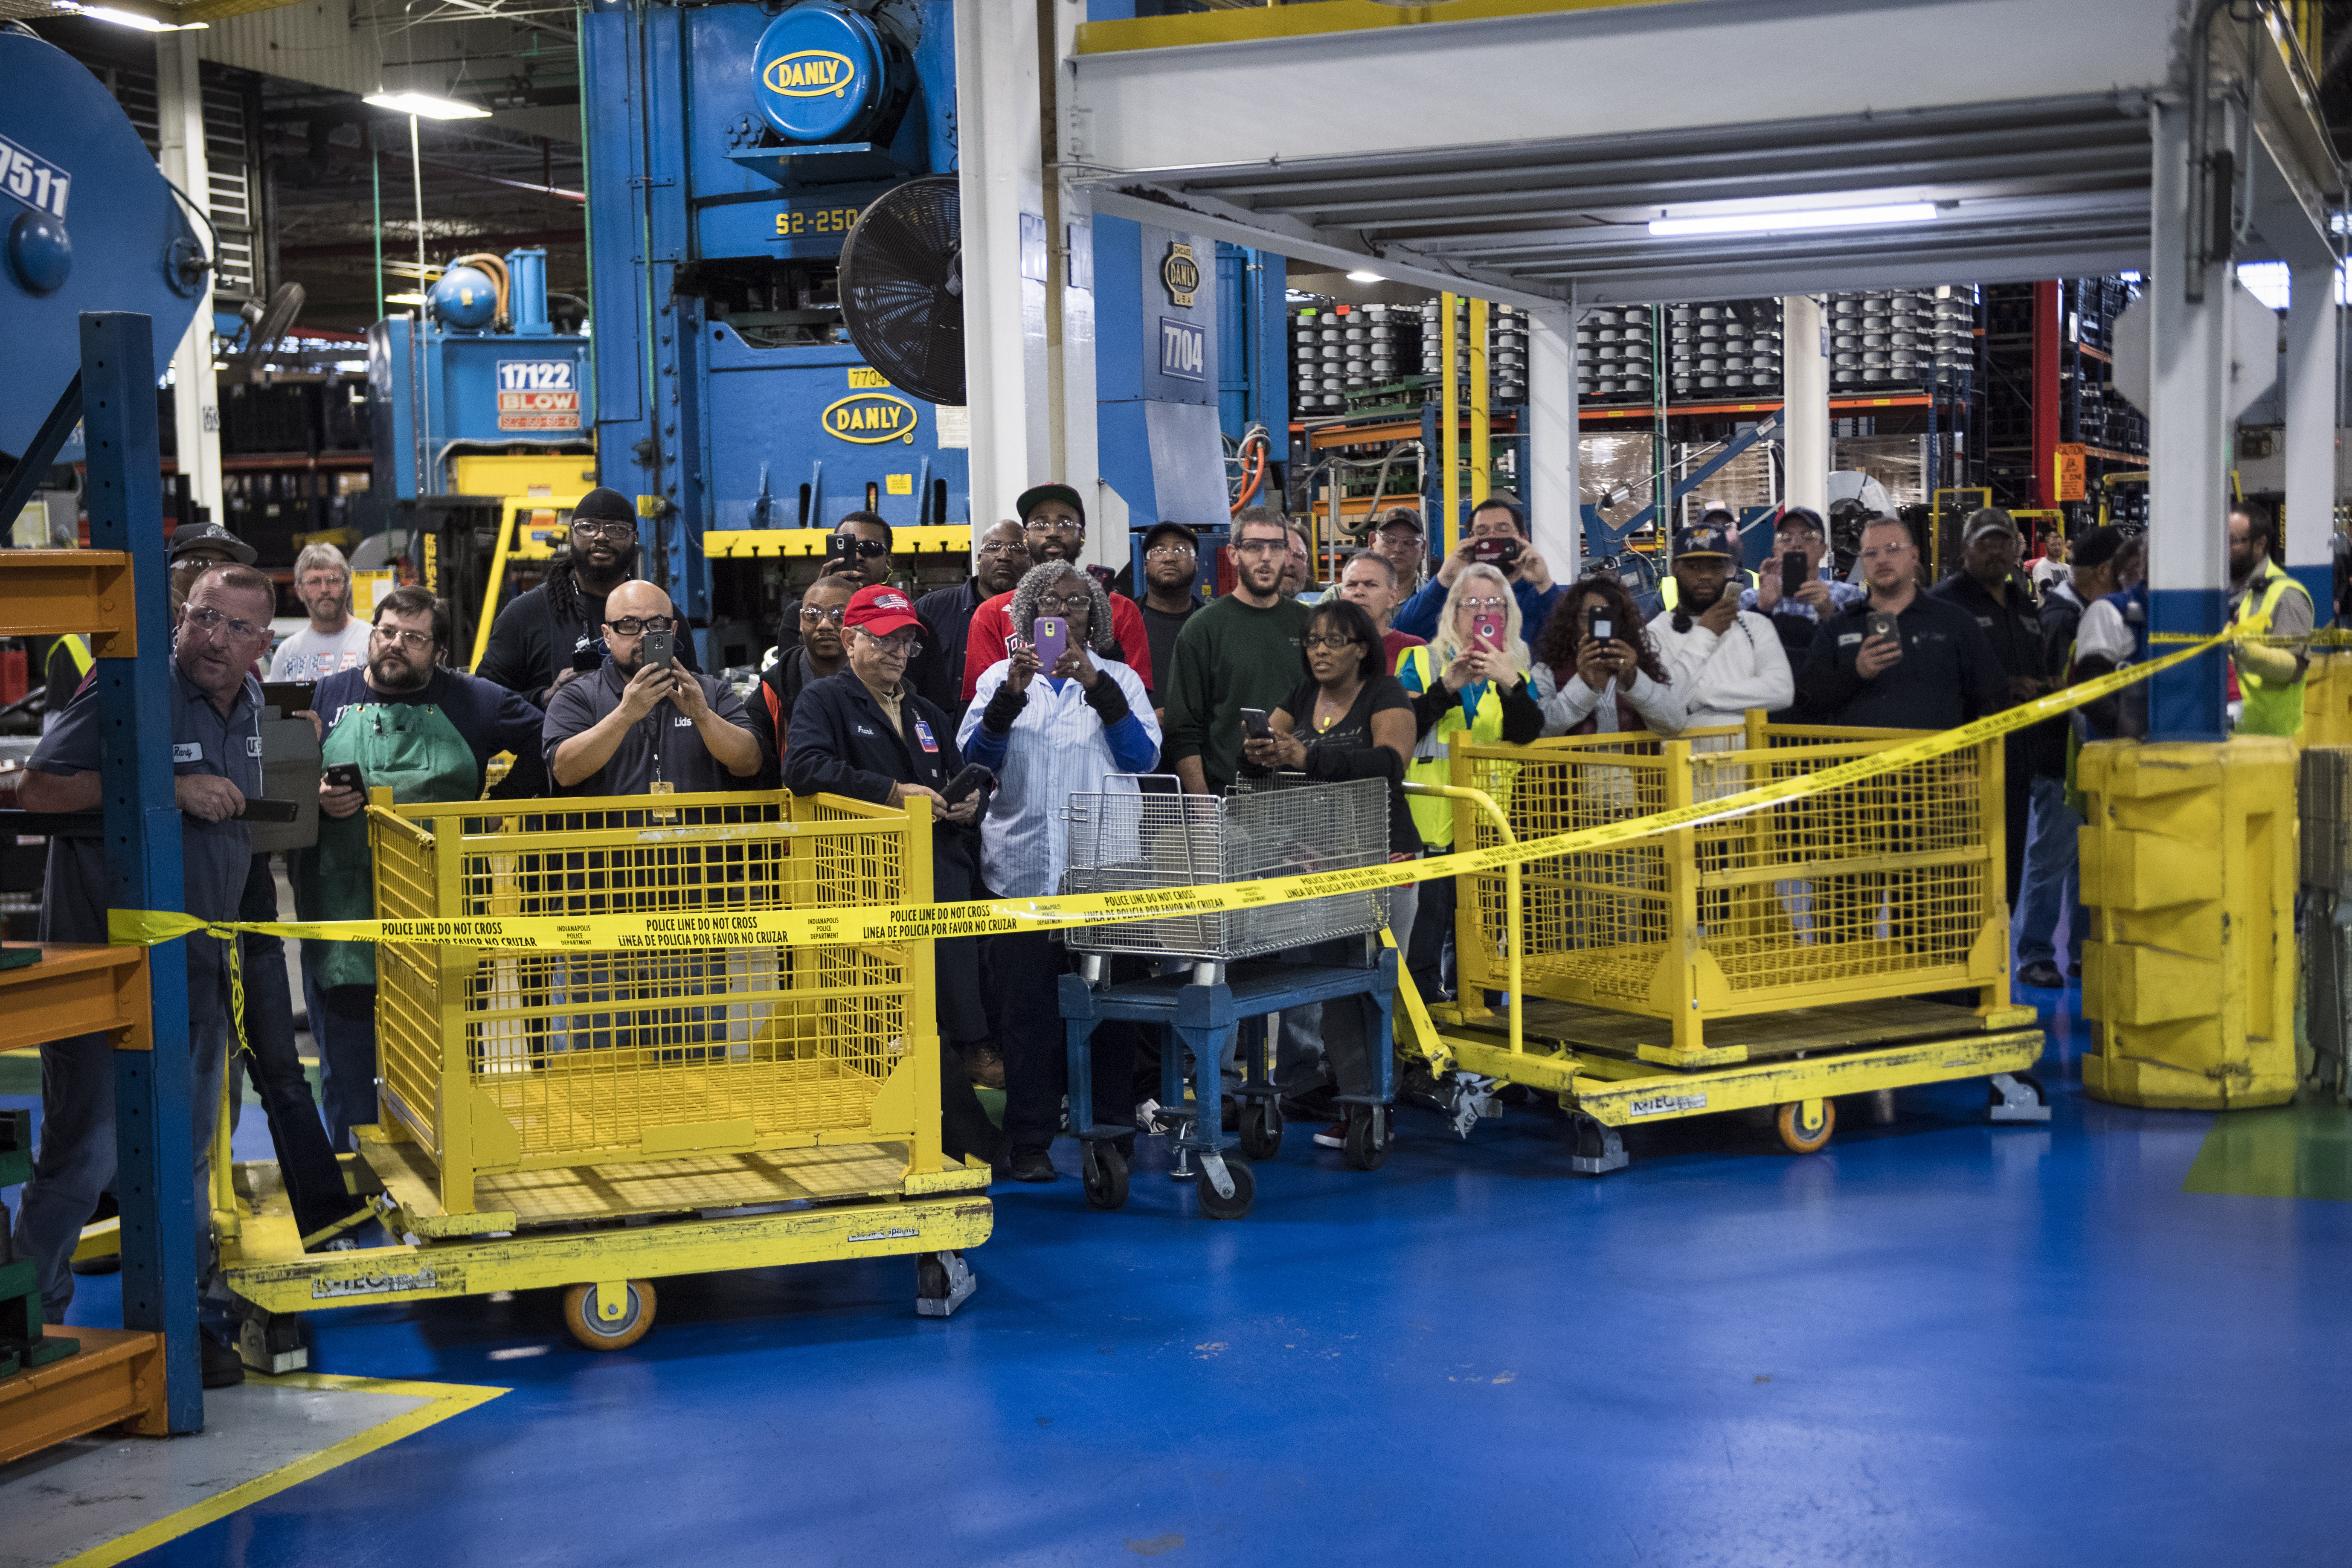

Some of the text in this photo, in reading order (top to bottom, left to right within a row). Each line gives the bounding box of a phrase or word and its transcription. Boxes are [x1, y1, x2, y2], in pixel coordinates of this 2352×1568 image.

[779, 60, 839, 87] DANLY
[1170, 263, 1196, 287] DANLY
[1164, 325, 1203, 373] 7704
[501, 363, 571, 389] 17122
[853, 370, 885, 386] 7704
[503, 394, 573, 409] BLOW
[837, 406, 901, 430] DANLY
[285, 651, 359, 681] USA
[675, 717, 692, 726] Lids
[858, 725, 874, 735] Frank
[1300, 868, 1386, 885] POLICE LINE DO NOT CROSS
[1104, 889, 1196, 906] POLICE LINE DO NOT CROSS
[890, 905, 990, 923] POLICE LINE DO NOT CROSS
[1084, 898, 1225, 923] LINEA DE POLICIA POR FAVOR NO CRUZAR
[382, 922, 502, 935] POLICE LINE DO NOT CROSS
[646, 916, 757, 932] POLICE LINE DO NOT CROSS
[863, 918, 1017, 939] LINEA DE POLICIA POR FAVOR NO CRUZAR
[501, 937, 537, 947] CRUZAR
[618, 930, 788, 947] LINEA DE POLICIA POR FAVOR NO CRUZAR
